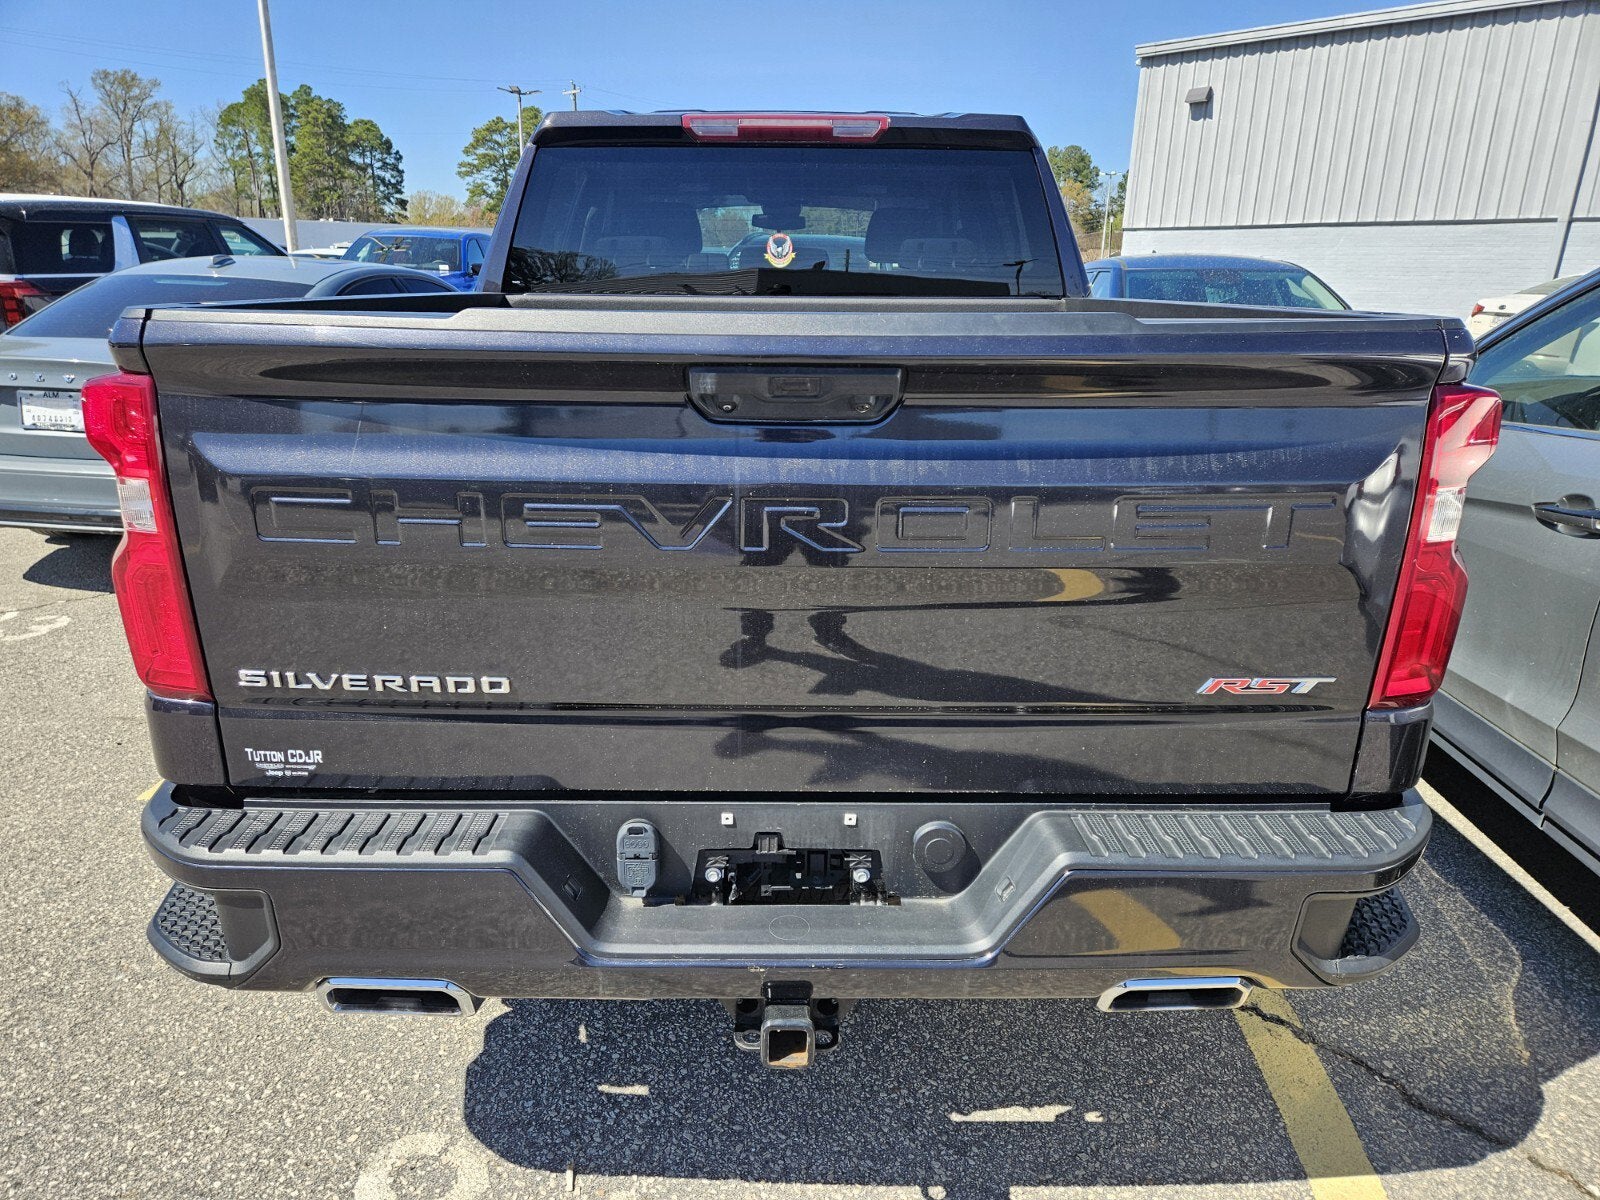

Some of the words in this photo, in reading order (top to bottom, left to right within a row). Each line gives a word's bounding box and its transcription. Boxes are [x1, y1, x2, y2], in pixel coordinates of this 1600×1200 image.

[43, 391, 60, 399] ALM
[251, 486, 1339, 553] CHEVROLET
[238, 669, 510, 693] SILVERADO
[1196, 677, 1337, 694] RST
[287, 749, 323, 763] CDJR
